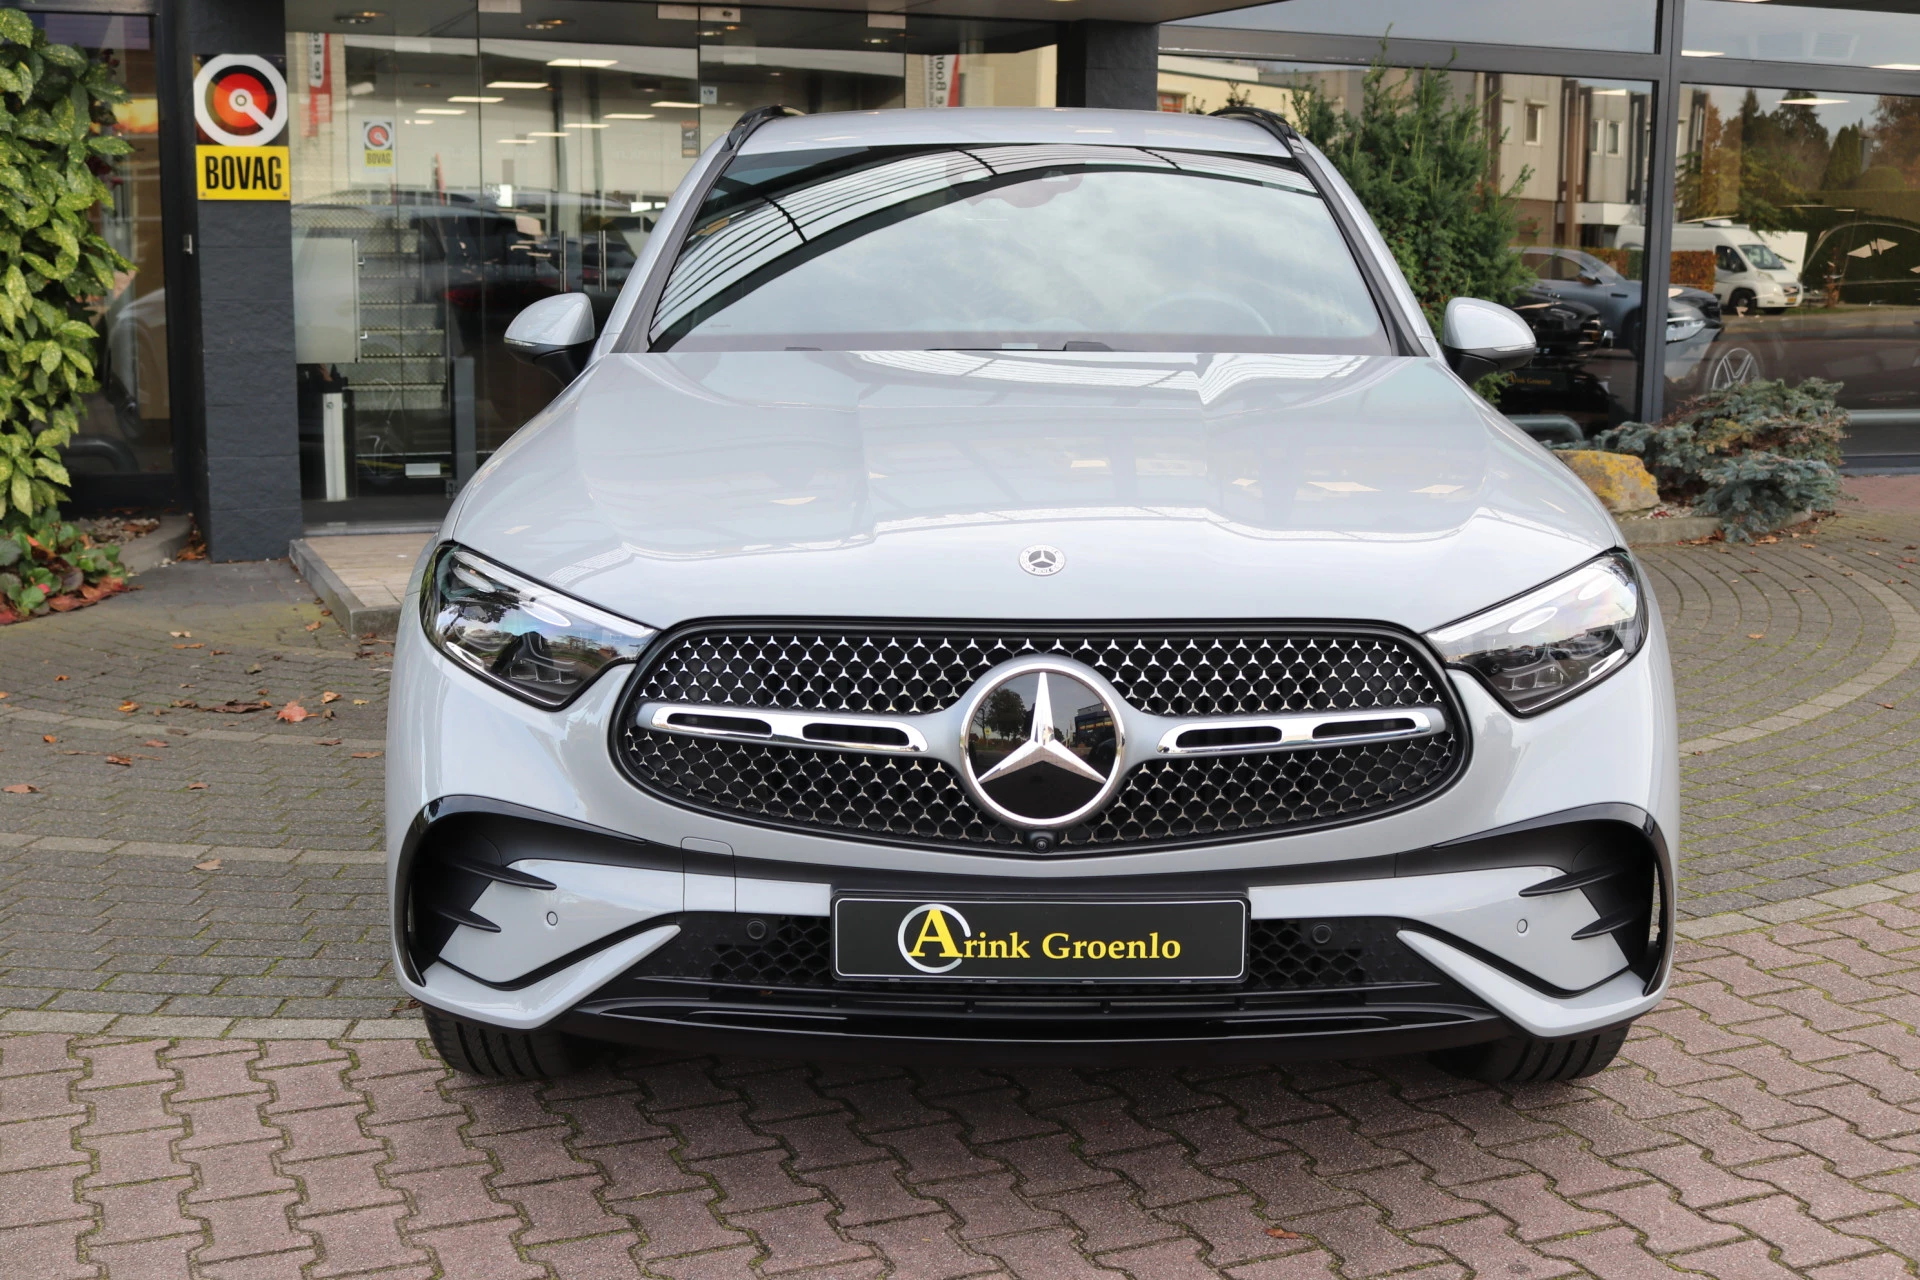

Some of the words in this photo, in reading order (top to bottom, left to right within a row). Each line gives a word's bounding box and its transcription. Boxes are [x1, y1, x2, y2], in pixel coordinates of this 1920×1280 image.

[205, 155, 282, 190] BOVAG
[366, 152, 392, 165] BOVAG
[907, 908, 1031, 958] Arink
[1042, 932, 1181, 959] Groenlo
